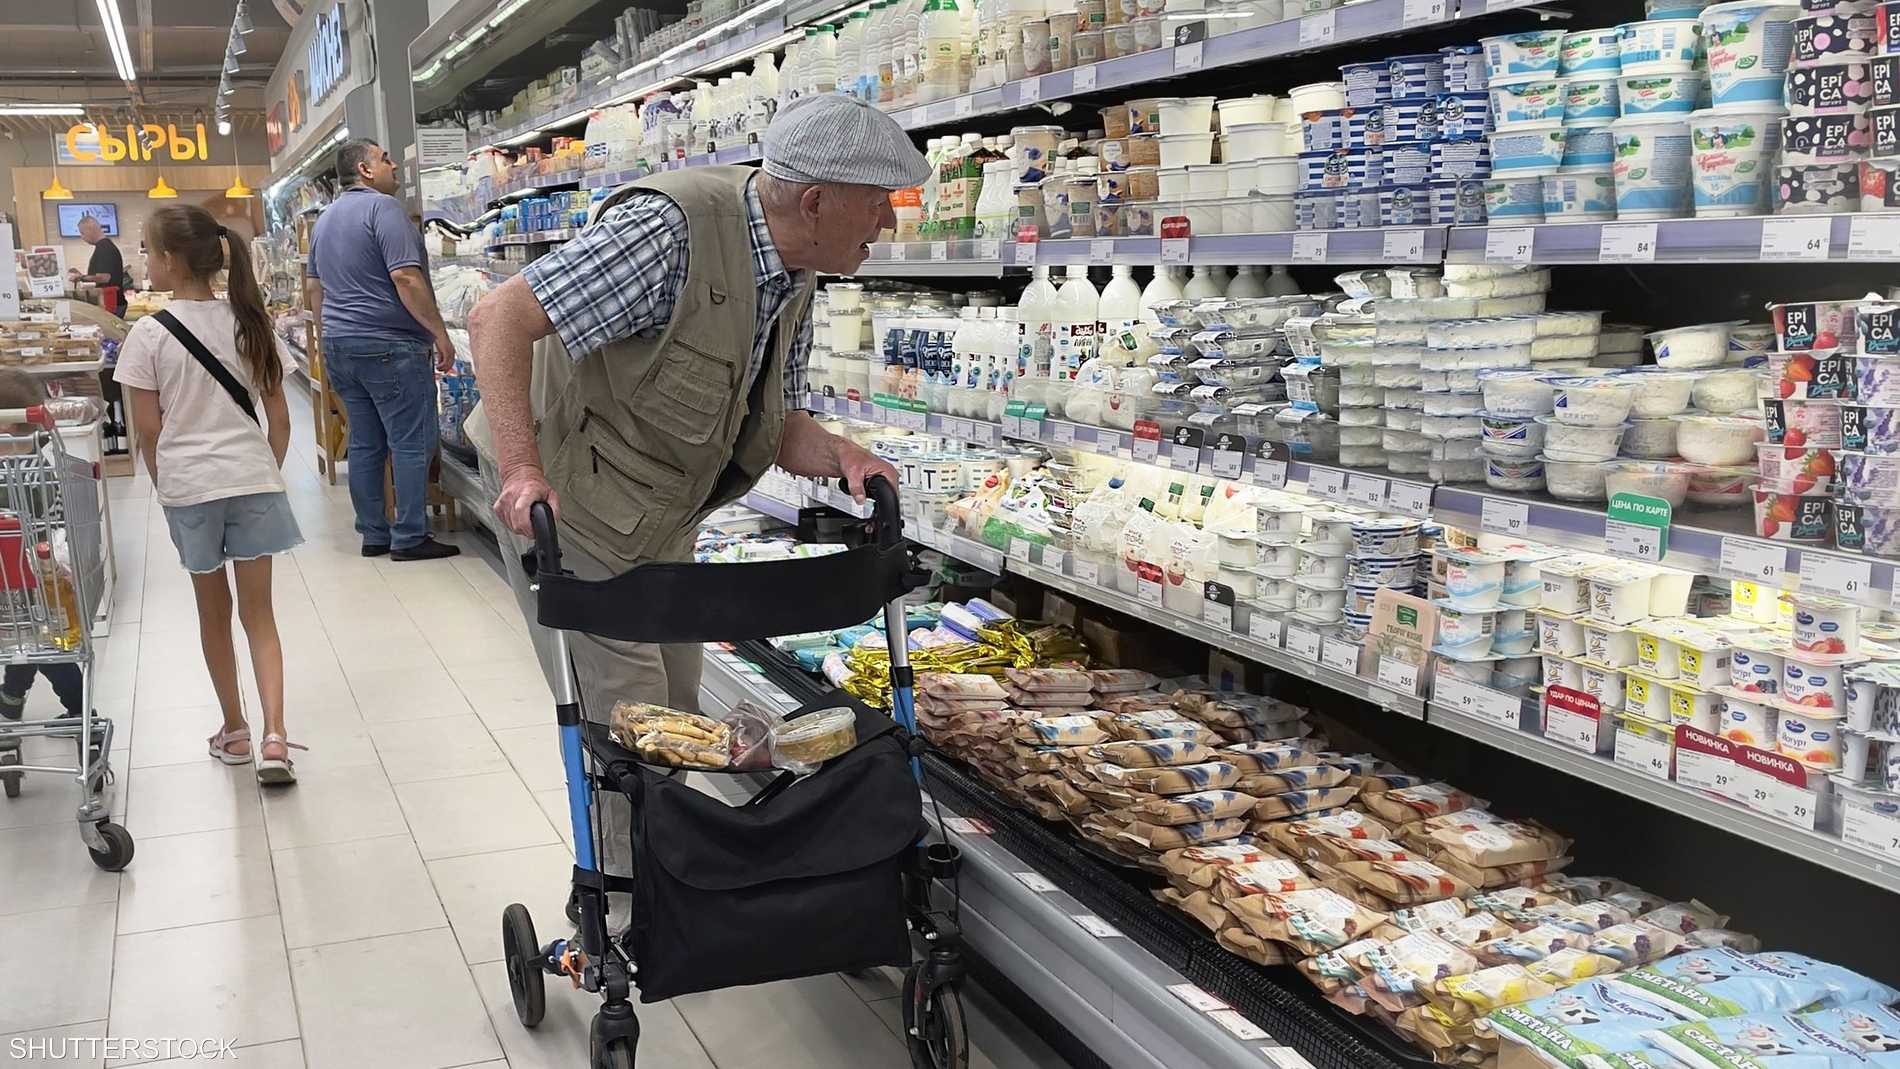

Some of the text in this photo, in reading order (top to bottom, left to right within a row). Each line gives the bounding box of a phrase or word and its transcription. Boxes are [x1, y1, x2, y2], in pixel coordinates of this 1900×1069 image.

[67, 122, 208, 161] СЫРЫ
[1637, 242, 1649, 252] 84
[1807, 239, 1821, 250] 64
[1517, 246, 1528, 255] 57
[1611, 499, 1669, 517] ЦЕНА ПО КАРТЕ
[1508, 518, 1520, 529] 107
[1638, 544, 1650, 555] 89
[1763, 565, 1774, 576] 61
[1856, 580, 1868, 592] 61
[1400, 676, 1412, 687] 255
[1463, 696, 1472, 705] 59
[1564, 694, 1575, 703] ПО
[1505, 711, 1515, 720] 54
[1579, 731, 1590, 742] 36
[1685, 729, 1731, 755] НОВИНКА
[1651, 758, 1663, 769] 46
[1746, 750, 1796, 775] НОВИНКА
[1716, 774, 1728, 785] 29
[1754, 788, 1767, 800] 29
[1793, 805, 1807, 817] 29
[1745, 959, 1796, 979] Корова
[1631, 970, 1714, 1009] СМЕТАНА
[1616, 1002, 1665, 1022] Корова
[1500, 1006, 1574, 1051] СМЕТАНА
[1683, 1028, 1764, 1069] СМЕТАН
